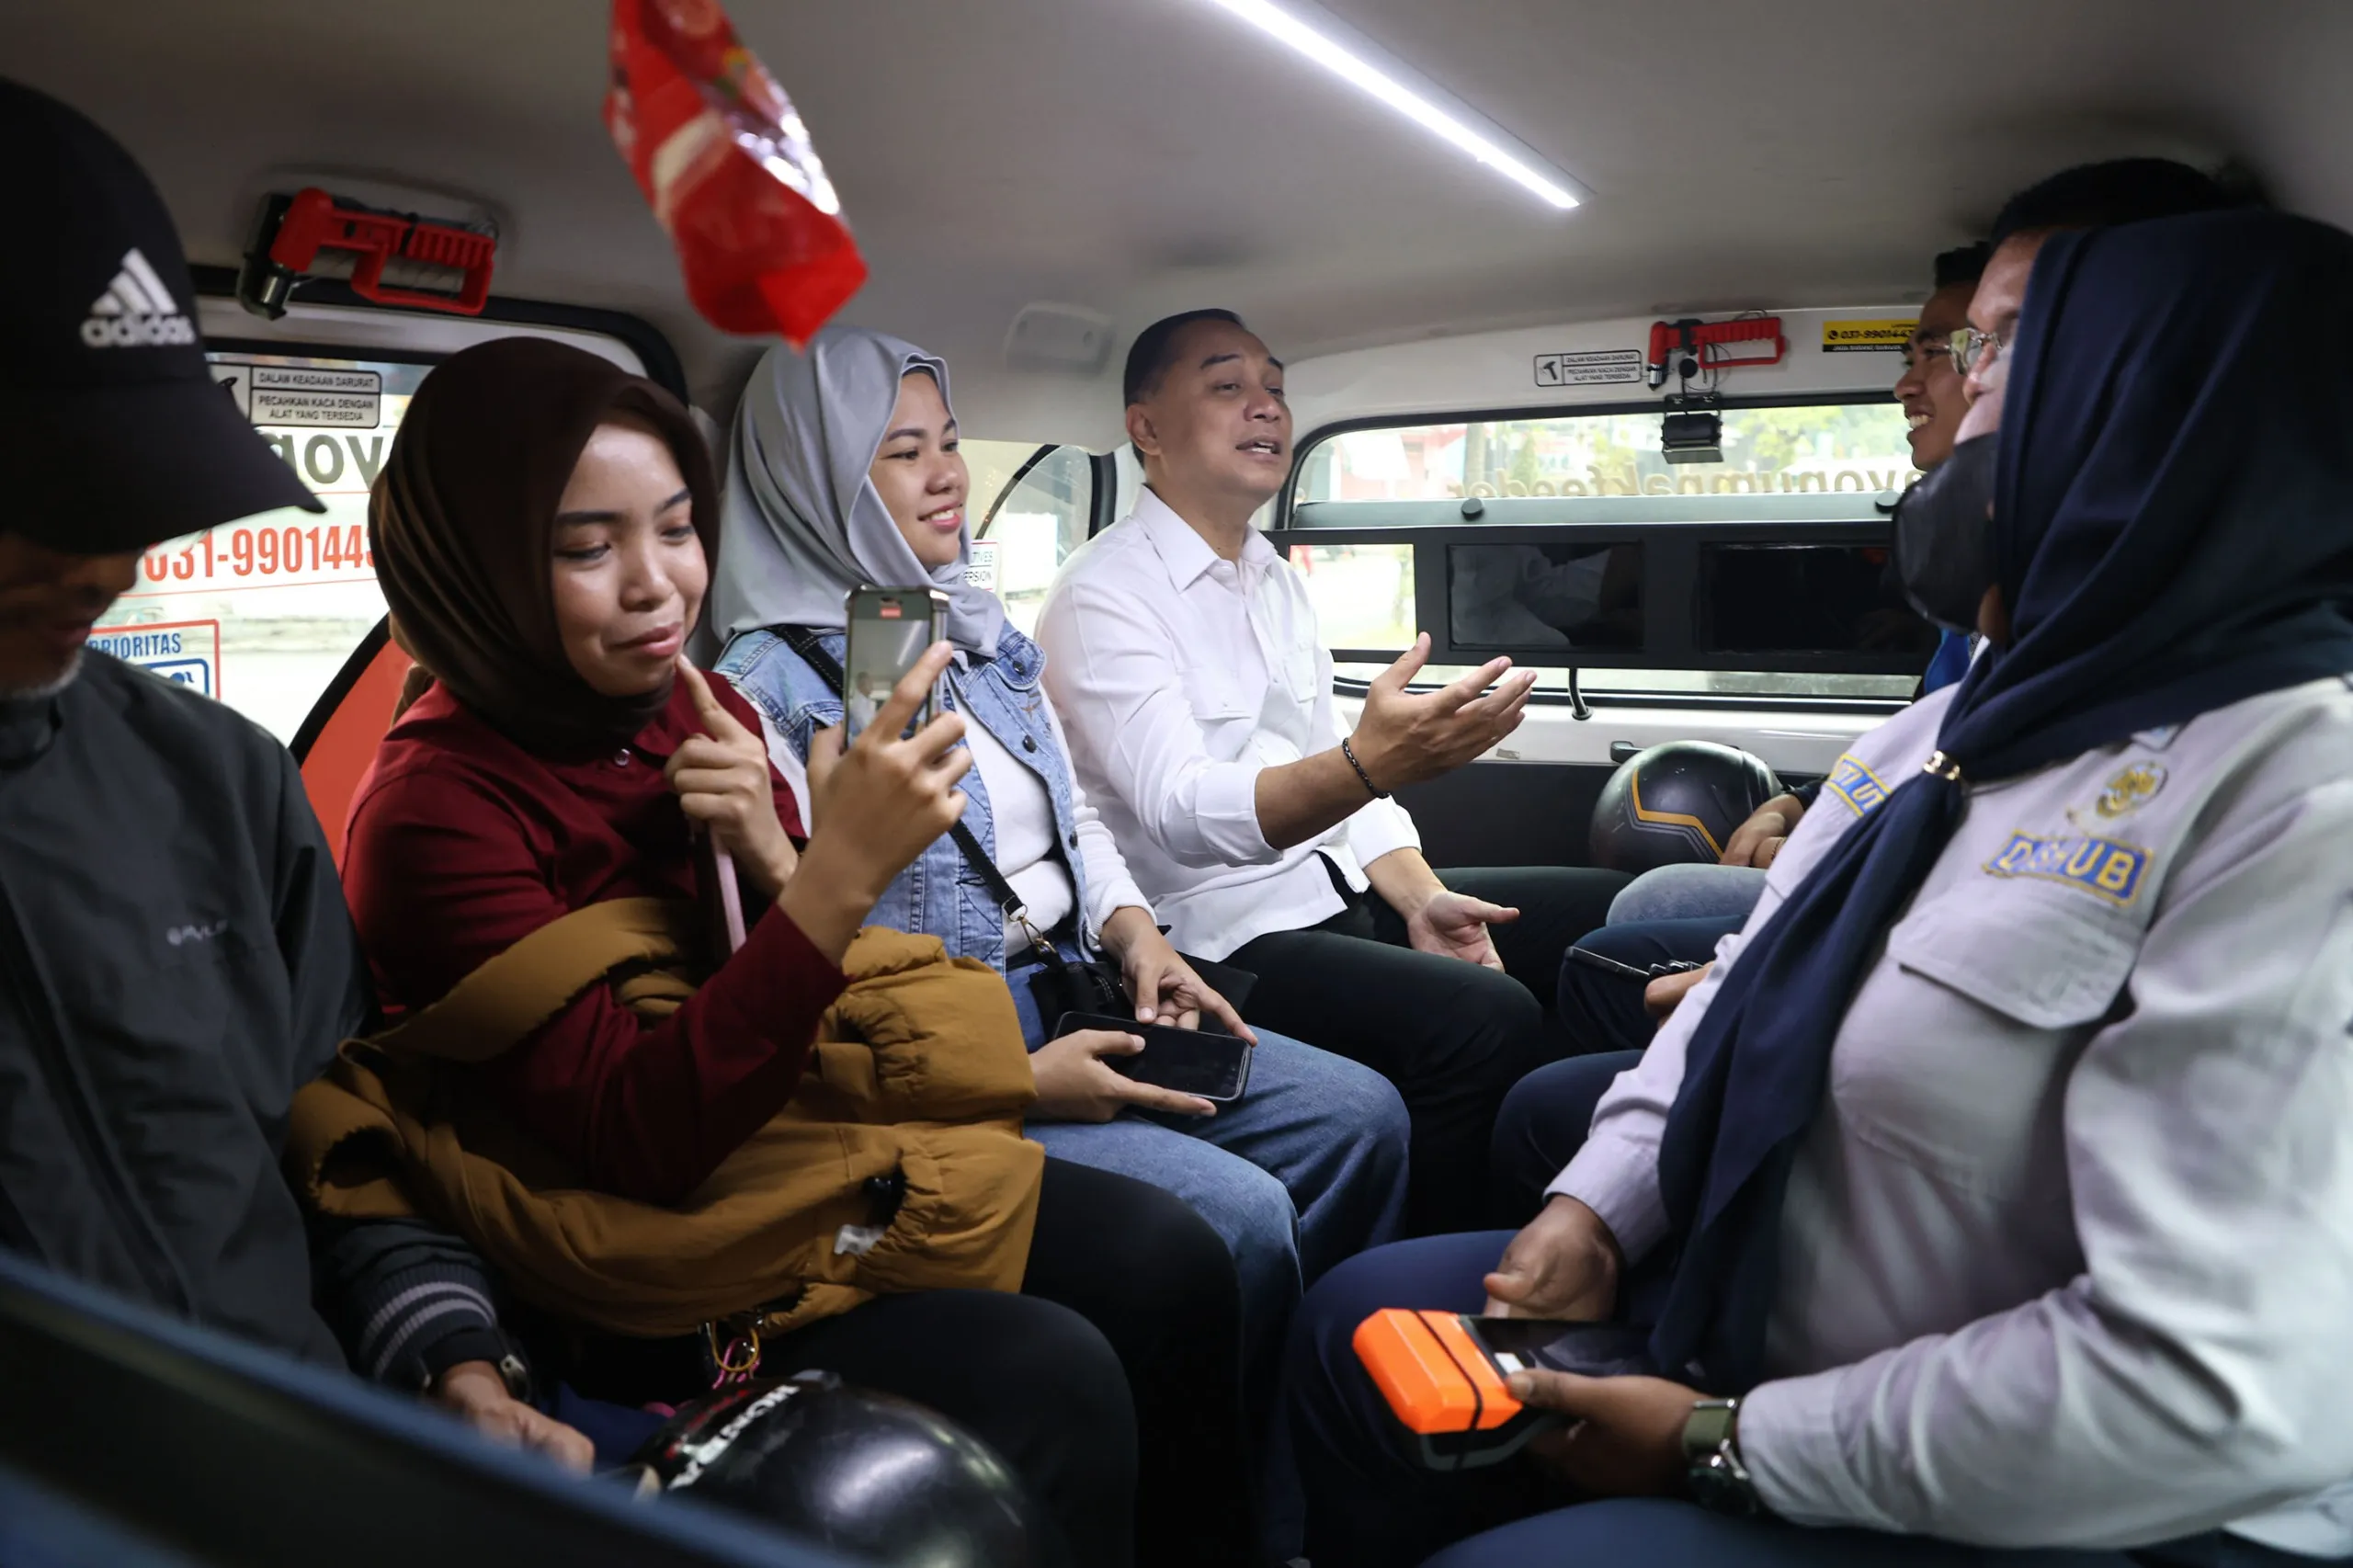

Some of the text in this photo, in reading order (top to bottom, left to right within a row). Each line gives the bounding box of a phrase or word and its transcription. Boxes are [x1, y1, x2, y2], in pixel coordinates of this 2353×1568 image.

[80, 313, 196, 347] adidas
[259, 372, 374, 388] DALAM KEADAAN DARURAT
[258, 395, 374, 410] PECAHKAN KACA DENGAN
[268, 409, 364, 422] ALAT YANG TERSEDIA
[144, 525, 375, 582] 031-990144
